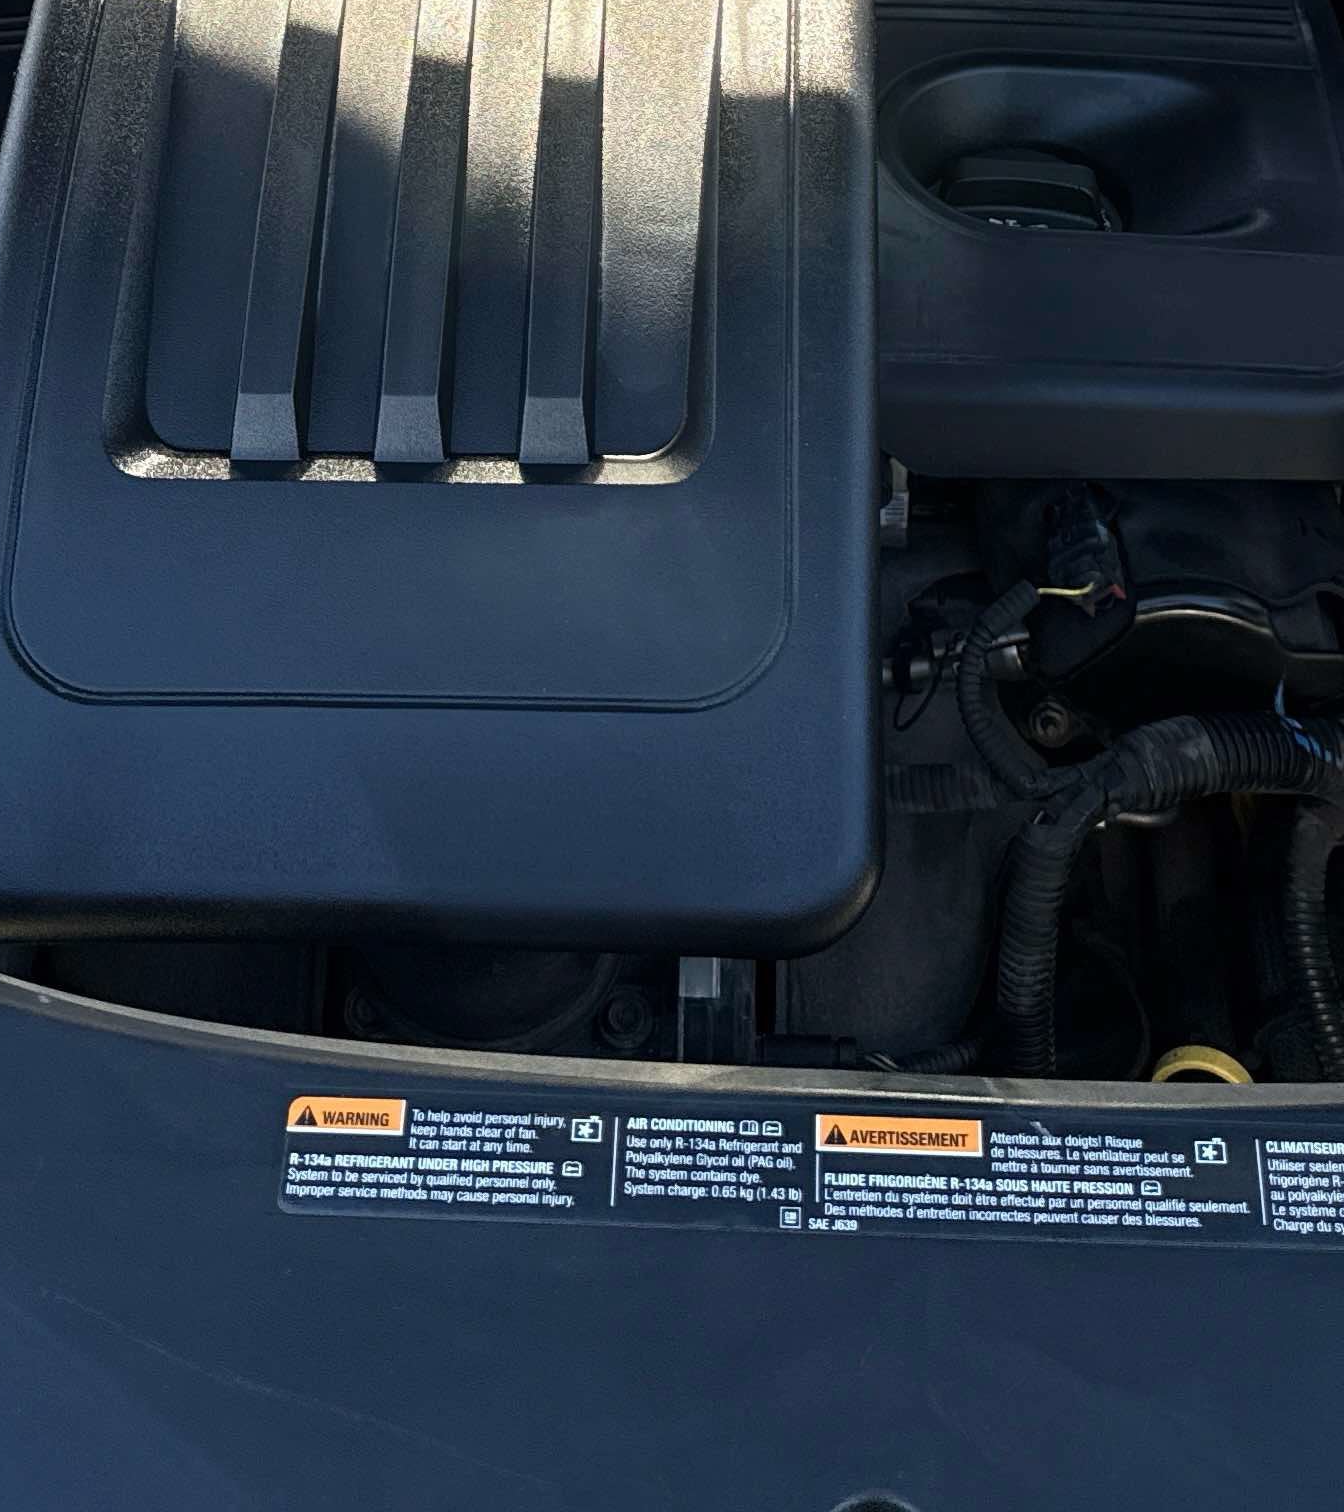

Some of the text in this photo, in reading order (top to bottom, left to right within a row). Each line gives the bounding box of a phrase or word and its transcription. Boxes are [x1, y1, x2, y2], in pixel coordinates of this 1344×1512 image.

[323, 1111, 389, 1126] WARNING
[412, 1109, 424, 1122] To
[427, 1109, 450, 1123] help
[453, 1111, 482, 1124] avoid
[485, 1113, 530, 1126] personal
[627, 1117, 735, 1133] AIR CONDITIONING
[411, 1124, 539, 1139] keep hands clear of fan.
[850, 1130, 968, 1147] AVERTISSEMENT
[409, 1137, 533, 1154] It can start at any time.
[627, 1135, 802, 1155] Use only R-134a Refrigerant and
[990, 1132, 1039, 1145] Attention
[1042, 1135, 1061, 1146] aux
[1105, 1136, 1142, 1150] Risque
[290, 1153, 554, 1174] R-134a REFRIGERANT UNDER HIGH PRESSURE
[625, 1151, 795, 1170] Polyalkylene Glycol oil (PAG oil).
[990, 1146, 1184, 1164] de blessures. Le ventilateur peut se
[992, 1161, 1194, 1178] mettre à tourner sans avertissement.
[1267, 1159, 1306, 1172] Utiliser
[288, 1168, 557, 1190] System to be serviced by qualified personnel only.
[625, 1167, 763, 1184] The system contains dye.
[824, 1173, 1133, 1194] FLUIDE FRIGORIGÈNE R-134a SOUS HAUTE PRESSION
[1269, 1174, 1329, 1188] frigorigène
[286, 1184, 574, 1207] Improper service methods may cause personal injury.
[624, 1181, 801, 1202] System charge: 0.65 kg (1.43 lb)
[1270, 1191, 1285, 1201] au
[885, 1190, 899, 1203] du
[902, 1191, 949, 1206] système
[952, 1192, 972, 1205] doit
[976, 1192, 997, 1206] être
[1001, 1195, 1045, 1206] effectué
[1049, 1197, 1067, 1209] par
[1070, 1199, 1084, 1208] un
[1088, 1198, 1141, 1211] personnel
[1145, 1200, 1186, 1213] qualifié
[1189, 1201, 1250, 1213] seulement.
[825, 1203, 846, 1216] Des
[849, 1203, 903, 1218] méthodes
[969, 1207, 1030, 1222] incorrectes
[1034, 1211, 1078, 1224] peuvent
[1082, 1214, 1119, 1224] causer
[1123, 1213, 1142, 1225] des
[1145, 1213, 1202, 1227] blessures.
[1272, 1203, 1286, 1216] Le
[1289, 1205, 1336, 1219] système
[809, 1217, 857, 1231] SAE J639
[1273, 1219, 1313, 1235] Charge
[1317, 1221, 1331, 1233] du
